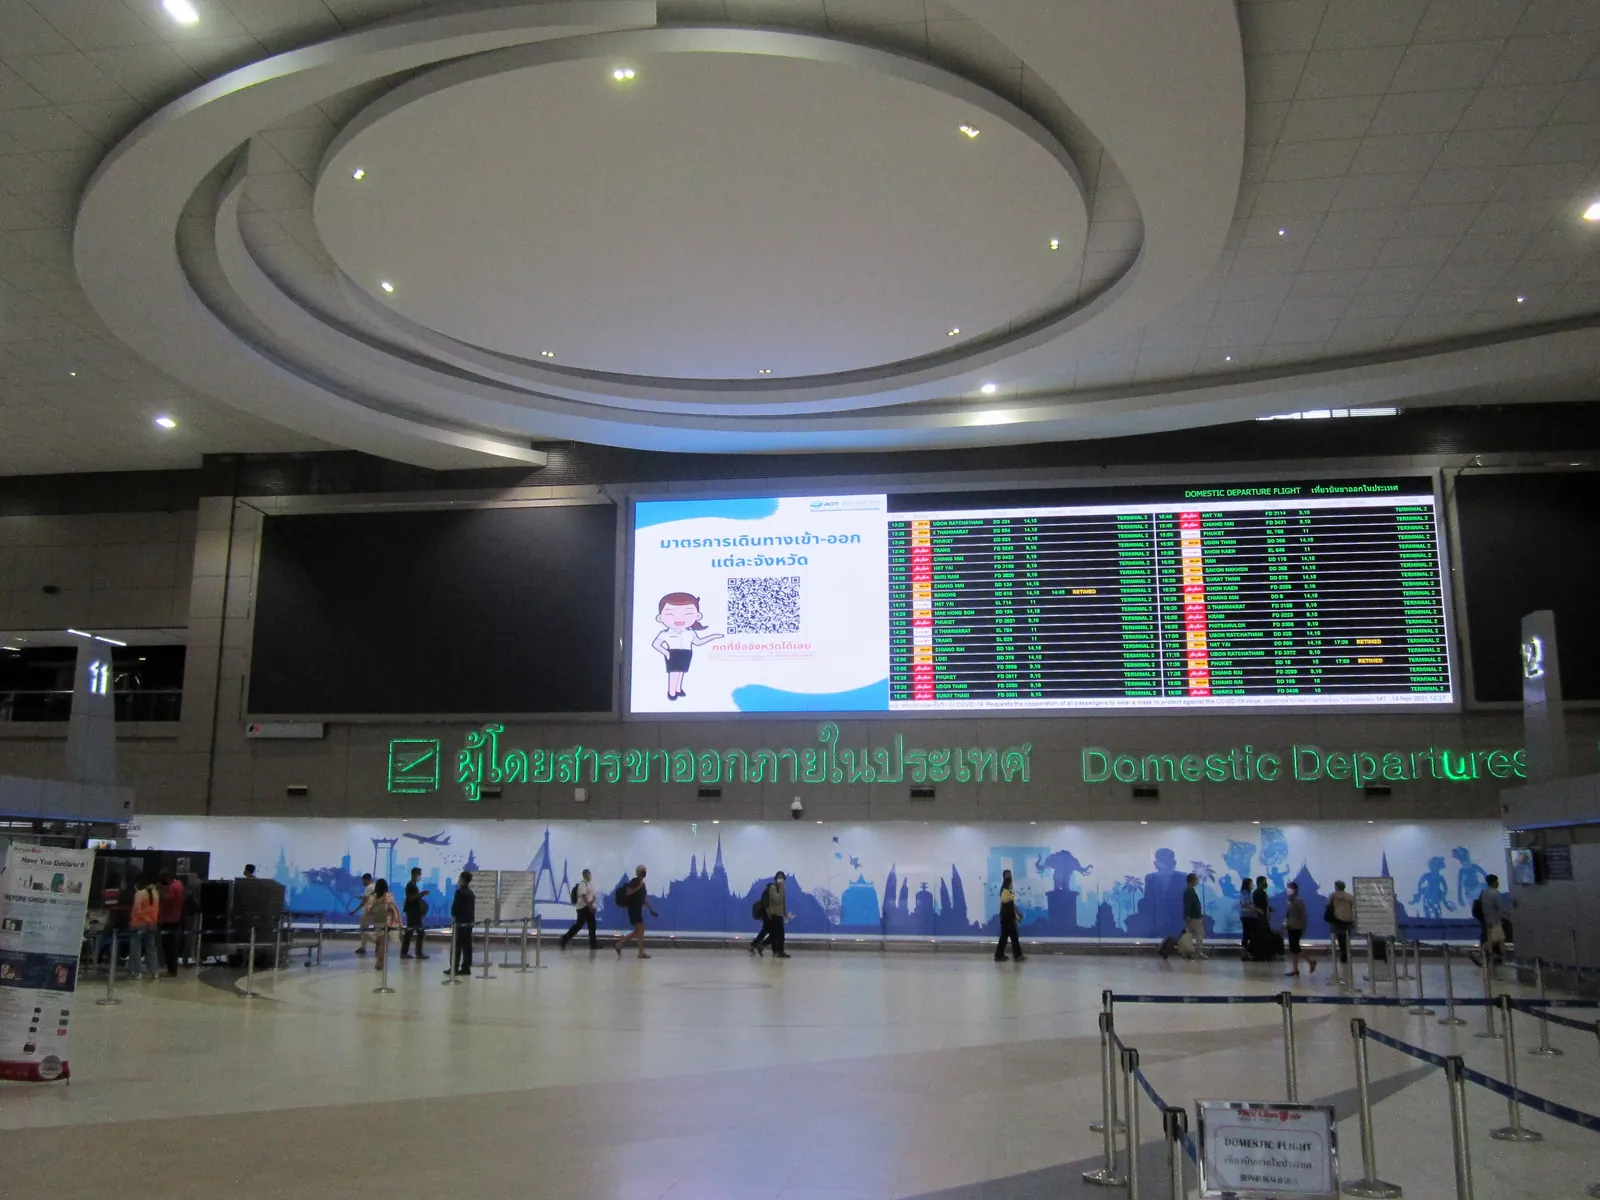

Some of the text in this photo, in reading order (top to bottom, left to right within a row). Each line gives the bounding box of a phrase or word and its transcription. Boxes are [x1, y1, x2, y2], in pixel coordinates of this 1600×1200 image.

[1185, 486, 1302, 498] DOMESTIC DEPARTURE FLIGHT
[660, 531, 862, 549] มาตรการเดินทางเข้า-ออก
[711, 553, 809, 569] แต่ละจังหวัด
[455, 722, 1034, 801] ผู้โดยสารขาออกภายในประเทศ
[1081, 744, 1280, 784] Domestic
[20, 856, 38, 865] Have
[1224, 1136, 1313, 1152] DOMESTIC FLIGHT
